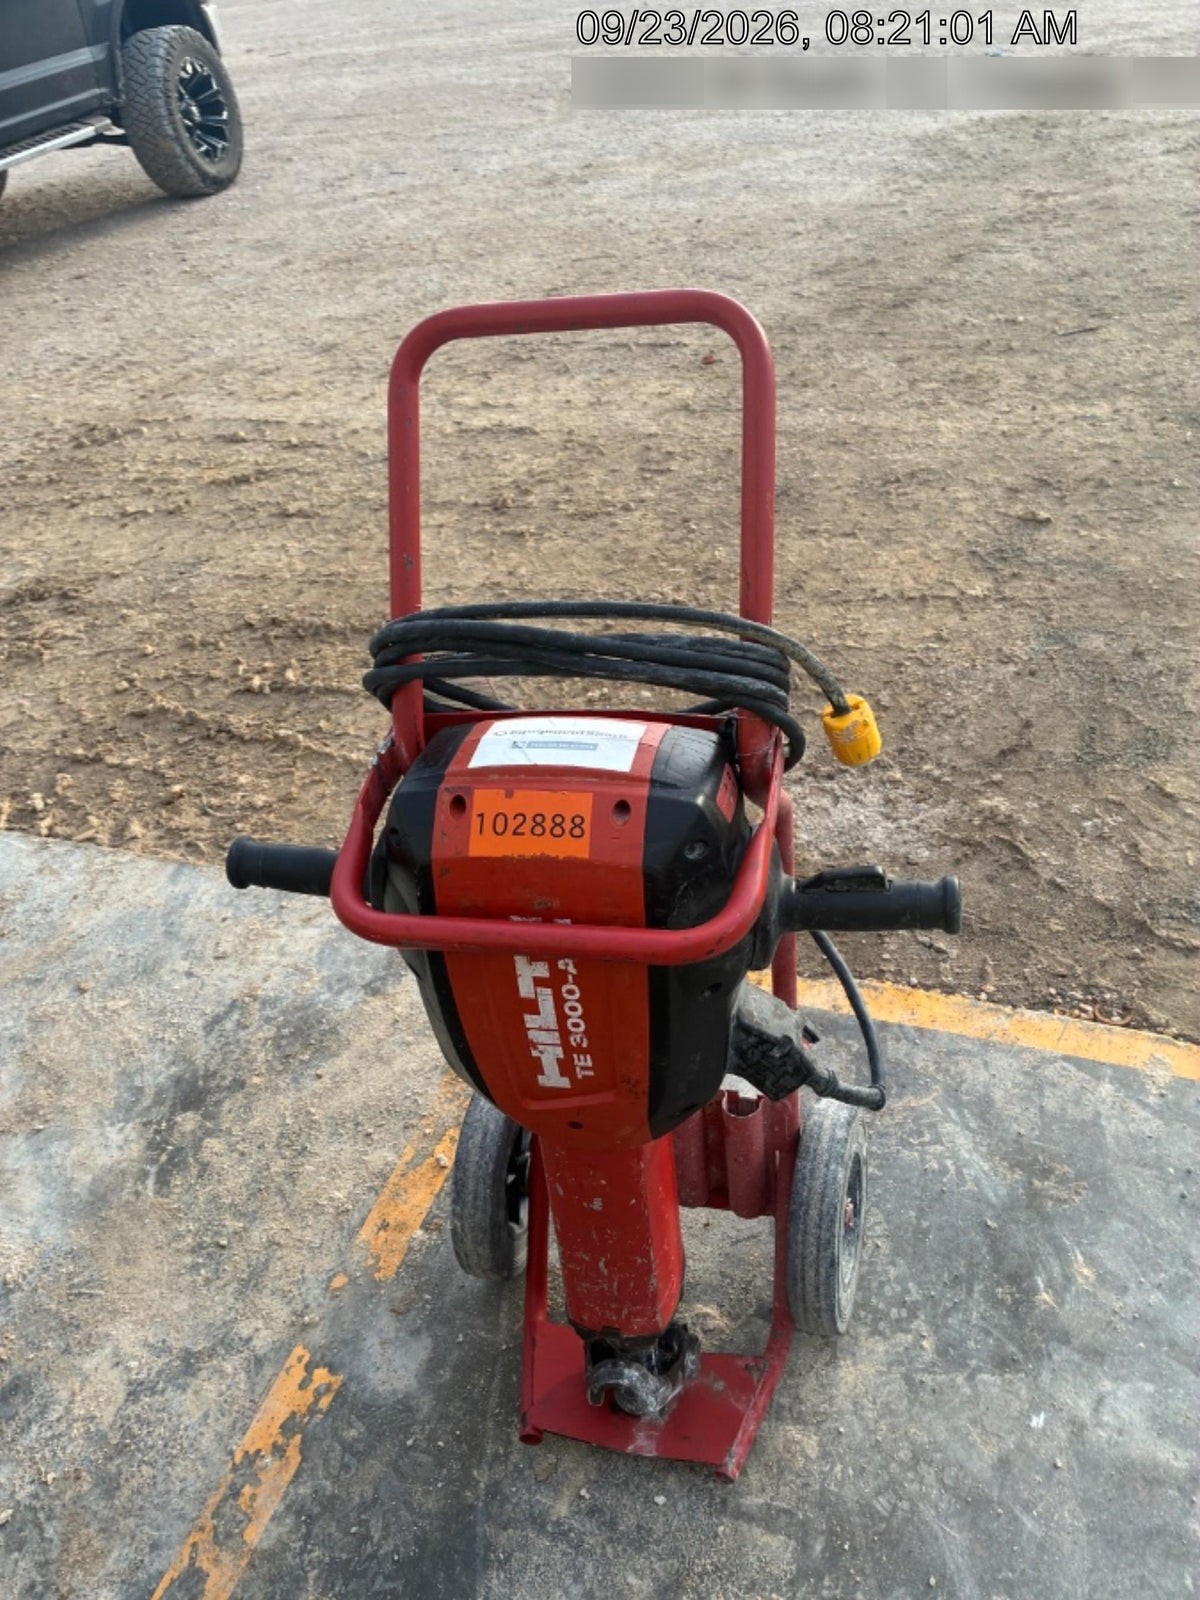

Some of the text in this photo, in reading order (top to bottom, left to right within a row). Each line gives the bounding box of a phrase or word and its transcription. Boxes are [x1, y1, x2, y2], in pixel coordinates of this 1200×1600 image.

[476, 812, 586, 839] 102888
[509, 915, 572, 1089] HILT
[572, 1053, 595, 1080] TE
